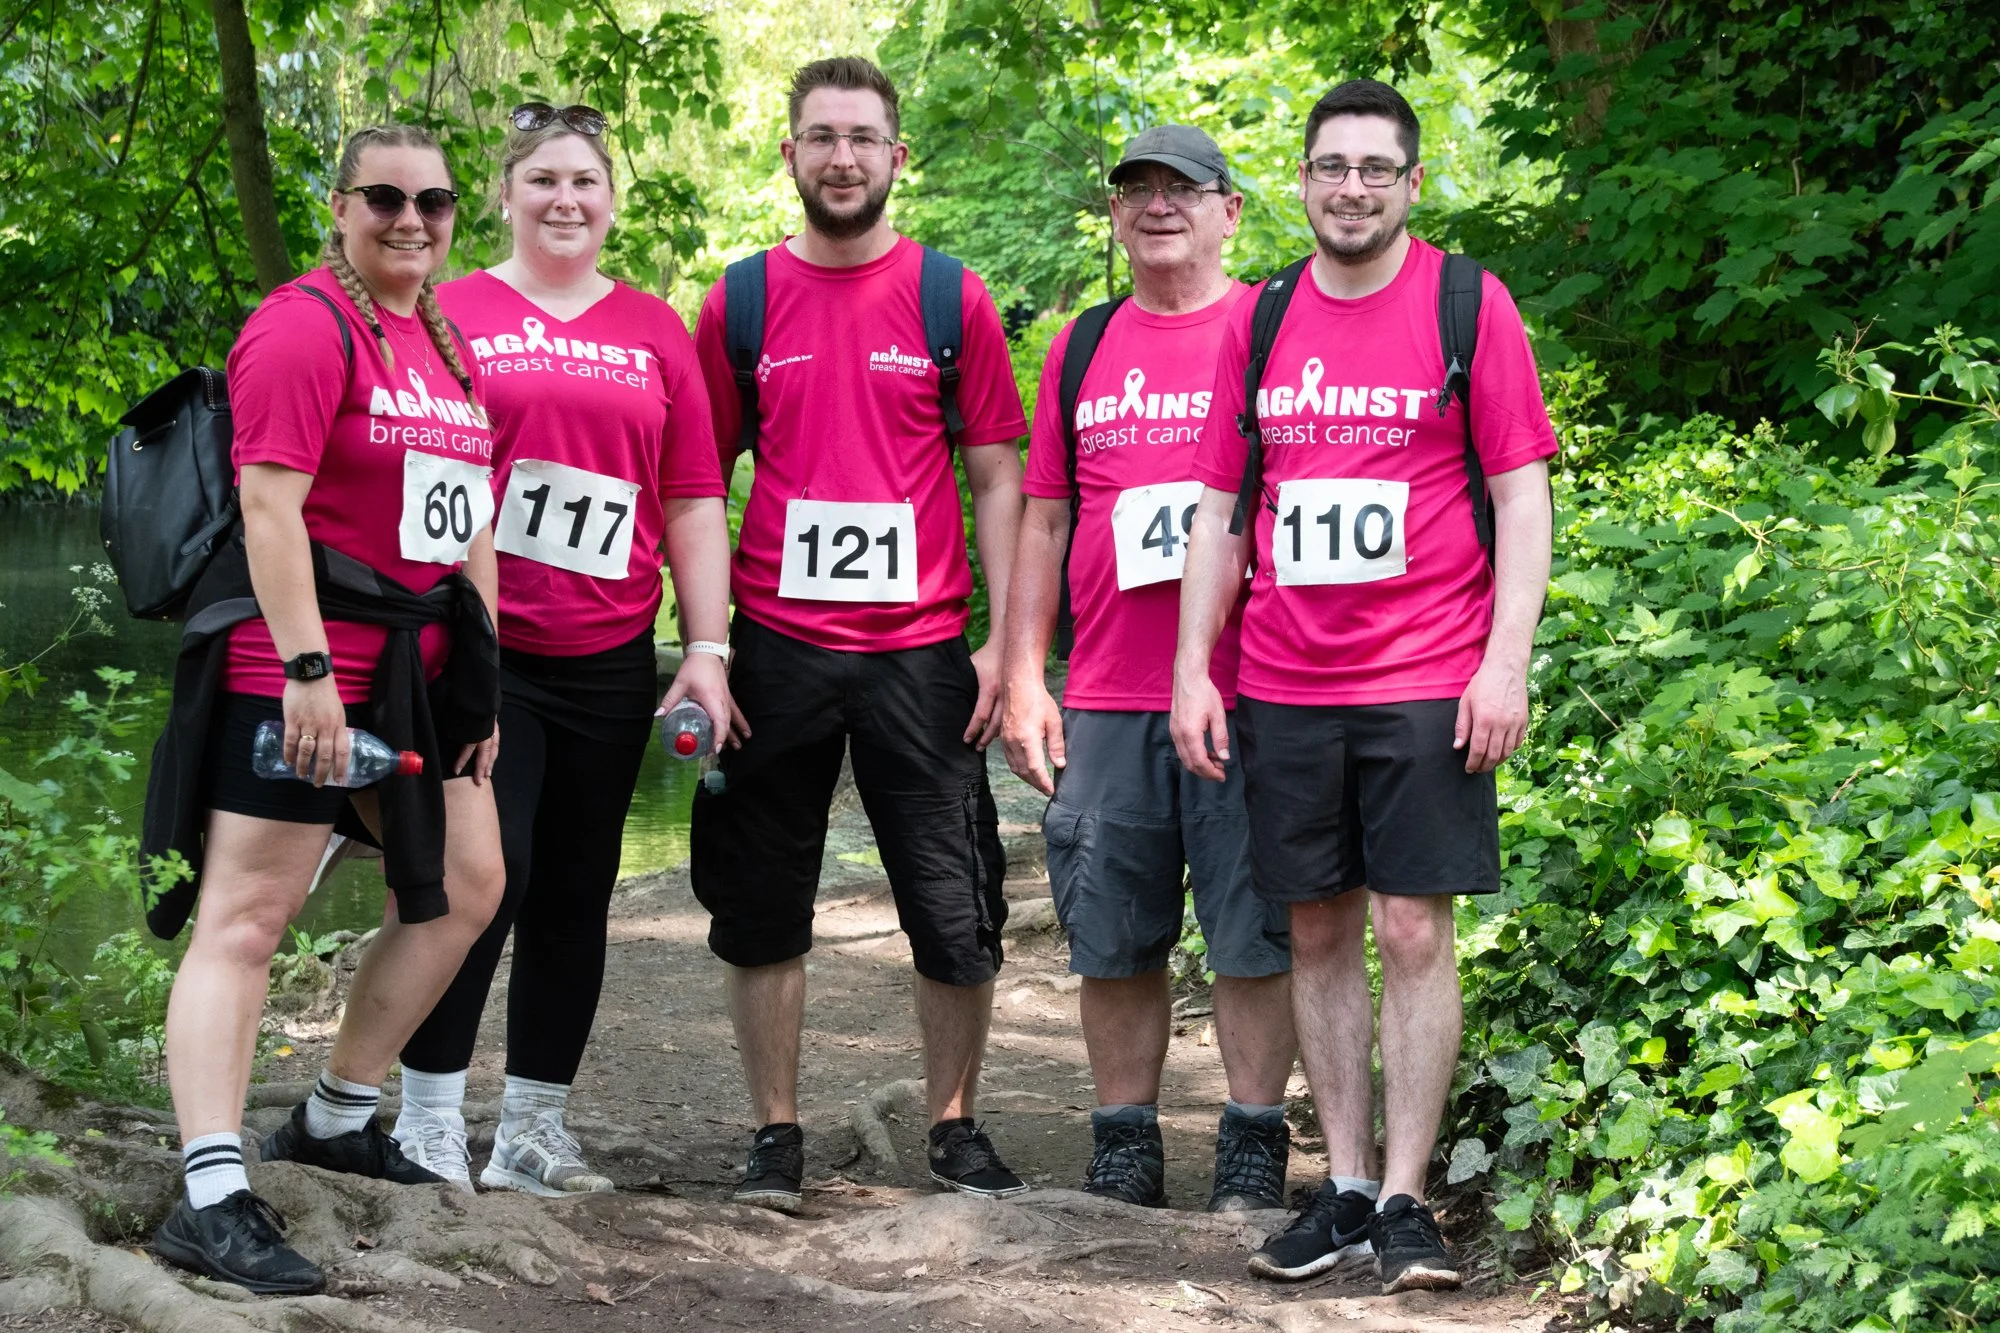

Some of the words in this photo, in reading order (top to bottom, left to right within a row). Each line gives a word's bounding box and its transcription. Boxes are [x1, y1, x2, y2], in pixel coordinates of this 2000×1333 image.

[563, 361, 649, 390] cancer
[869, 362, 897, 373] breast
[898, 366, 927, 377] cancer
[369, 367, 488, 430] AGAINS
[1076, 368, 1213, 431] AGAINS
[370, 418, 447, 449] breast
[452, 434, 493, 460] canc
[1080, 423, 1137, 455] breast
[1146, 426, 1204, 445] canc
[1325, 425, 1416, 447] cancer
[424, 480, 472, 544] 60
[522, 483, 628, 556] 117
[1283, 503, 1394, 562] 110
[797, 524, 898, 580] 121
